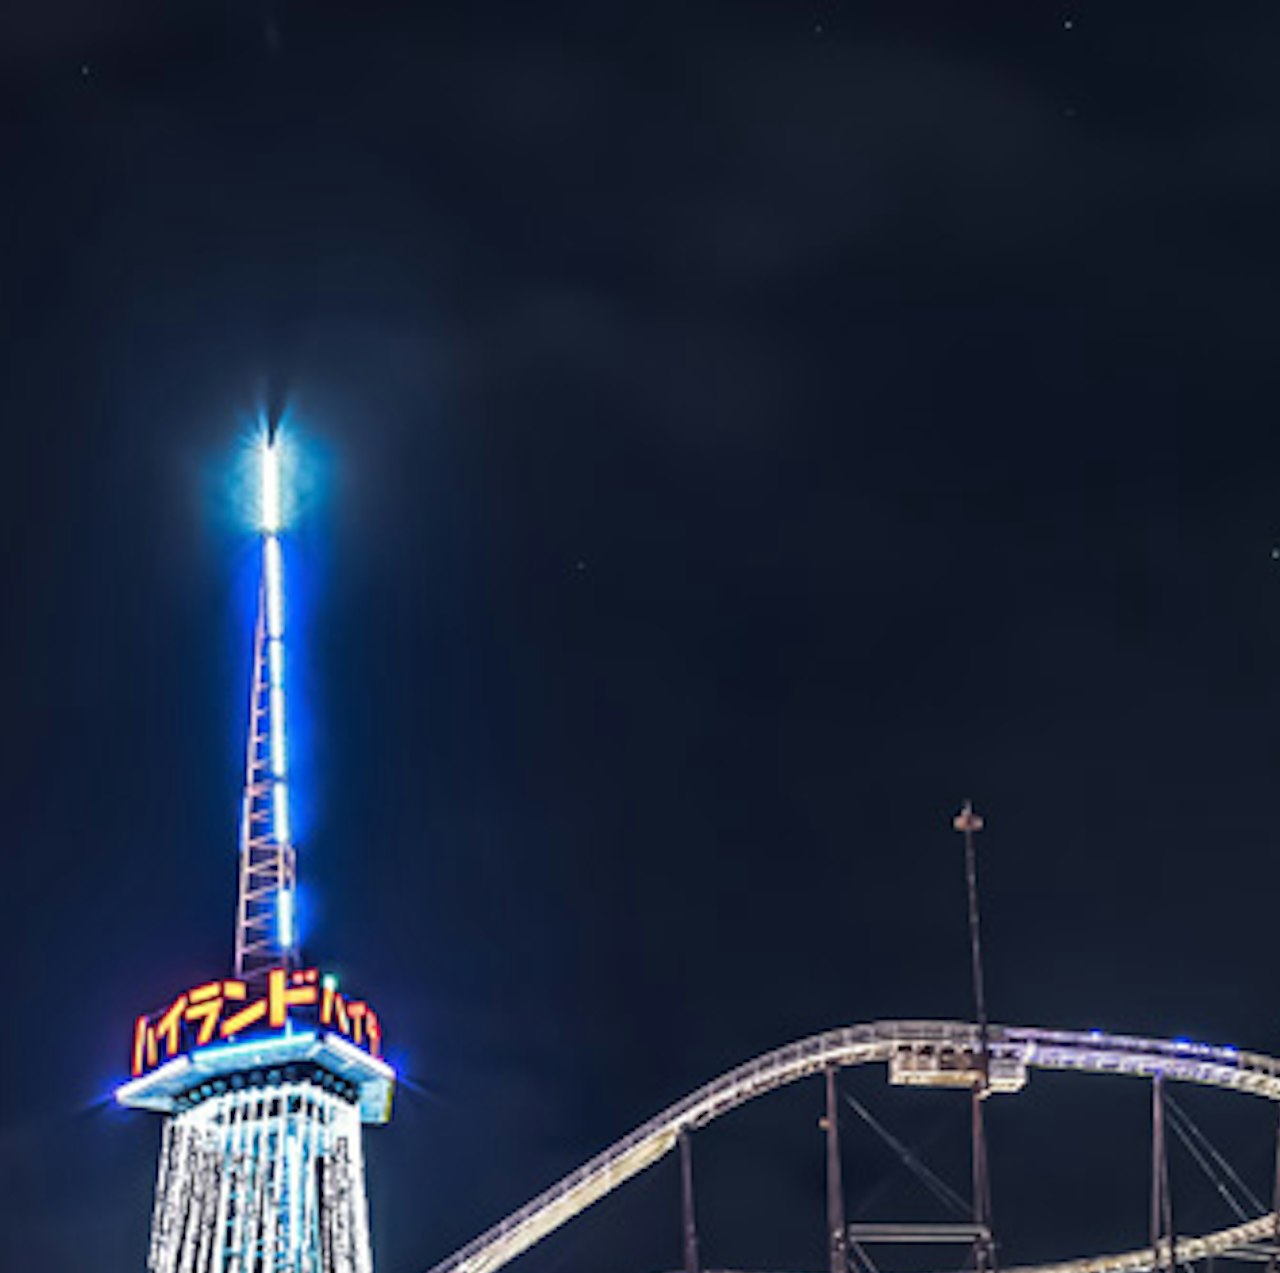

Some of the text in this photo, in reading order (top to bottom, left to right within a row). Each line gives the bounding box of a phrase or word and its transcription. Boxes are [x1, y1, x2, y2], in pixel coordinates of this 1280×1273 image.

[131, 967, 319, 1077] ハイランド
